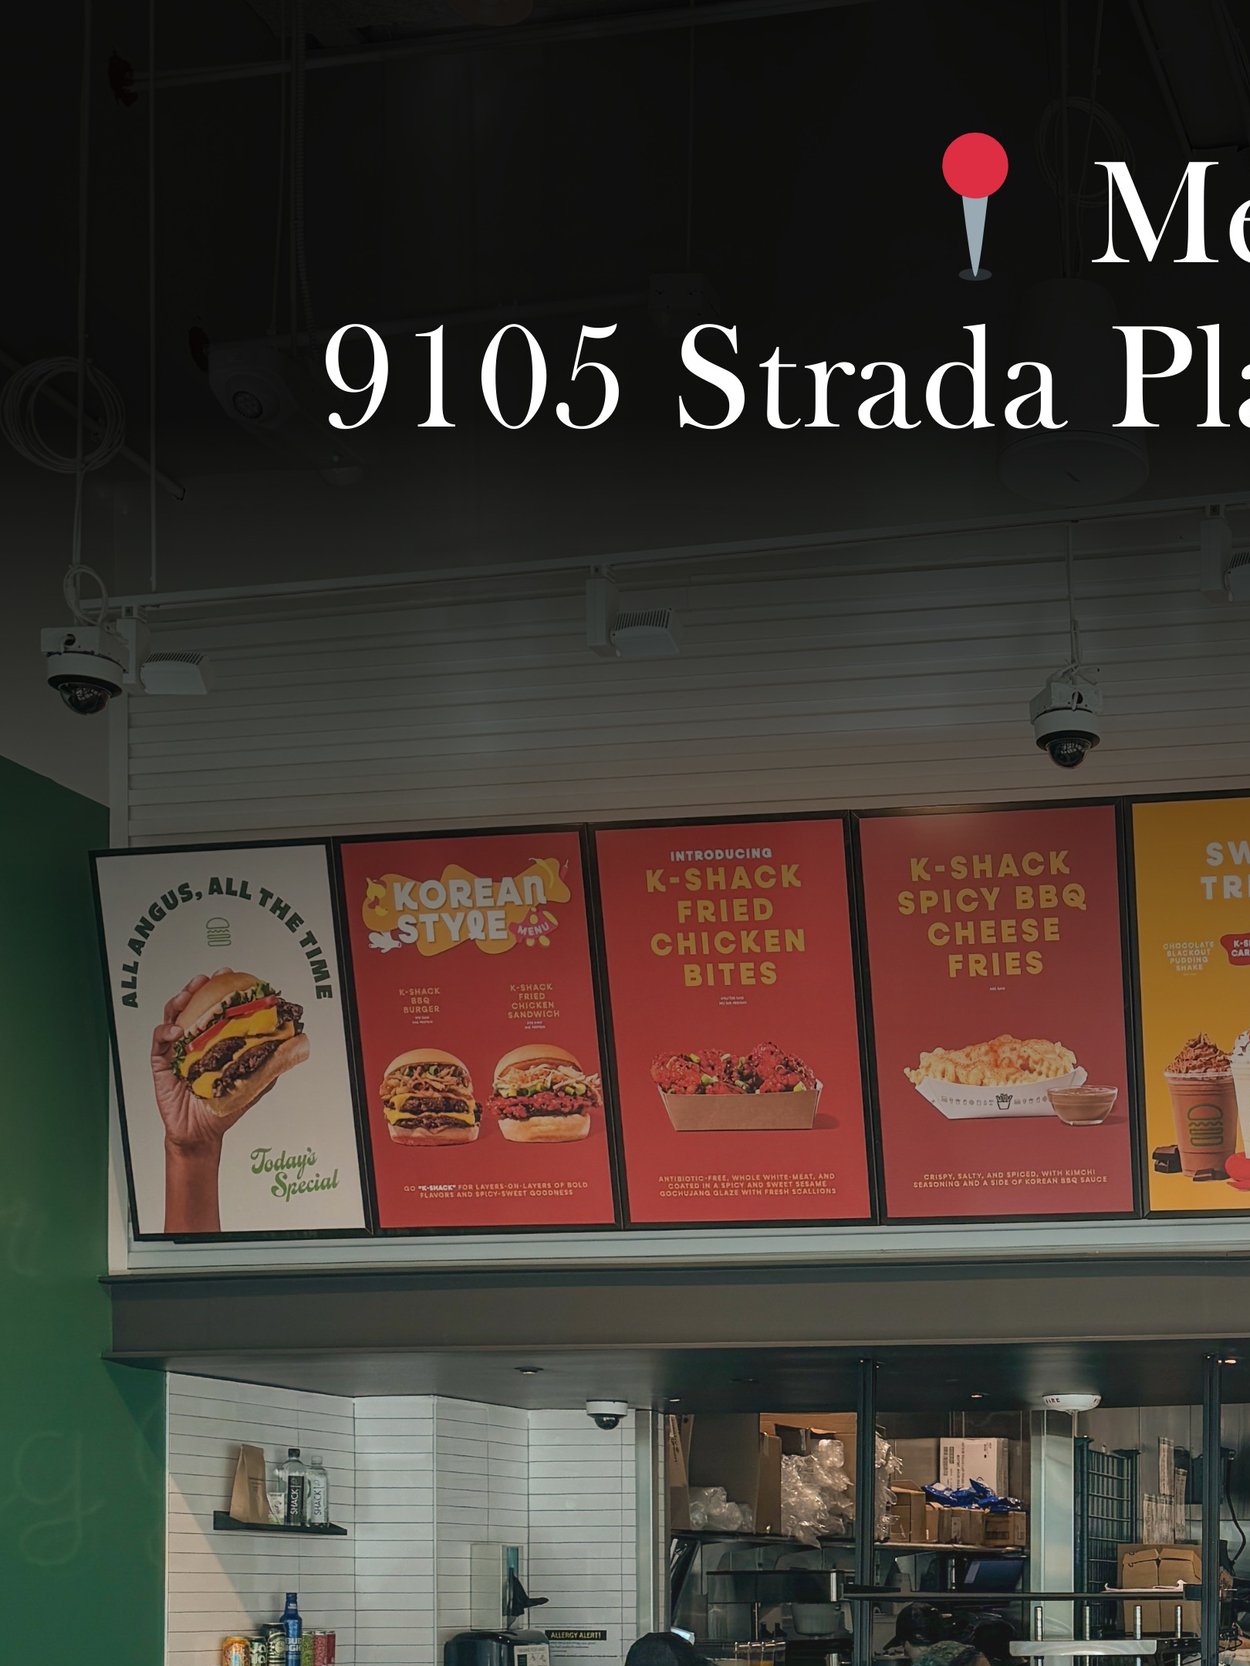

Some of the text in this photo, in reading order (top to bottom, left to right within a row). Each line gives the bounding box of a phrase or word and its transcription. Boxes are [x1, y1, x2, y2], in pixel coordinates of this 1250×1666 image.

[670, 848, 773, 861] INTRODUCING
[910, 850, 1071, 882] K-SHACK
[646, 864, 802, 893] K-SHACK
[898, 883, 1087, 915] SPICY BBQ
[677, 898, 774, 924] FRIED
[517, 922, 550, 940] MENU
[927, 917, 1060, 947] CHEESE
[122, 877, 334, 1008] ALL ANGUS, ALL THE TIME
[650, 929, 805, 956] CHICKEN
[1162, 941, 1214, 950] CHOCOLATE
[948, 950, 1043, 978] FRIES
[1169, 956, 1208, 964] PUDDING
[1176, 963, 1204, 972] SHAKE
[683, 961, 778, 987] BITES
[399, 987, 440, 996] K-SHACK
[509, 983, 553, 992] K-SHACK
[411, 997, 430, 1005] BBQ
[518, 992, 546, 1001] FRIED
[403, 1005, 440, 1014] BURGER
[511, 1001, 555, 1009] CHICKEN
[507, 1009, 560, 1019] SANDWICH
[251, 1147, 318, 1180] Today's
[818, 1172, 836, 1180] AND
[913, 1180, 960, 1188] SEASONING
[1025, 1177, 1057, 1185] KOREAN
[1060, 1176, 1079, 1184] BBQ
[271, 1169, 340, 1202] Special
[668, 1182, 700, 1190] COATED
[721, 1181, 744, 1189] SPICY
[795, 1180, 828, 1188] SESAME
[792, 1187, 837, 1195] SCALLIONS
[290, 1487, 299, 1515] SHACK
[313, 1489, 322, 1516] SHACK
[550, 1631, 579, 1640] ALLERGY
